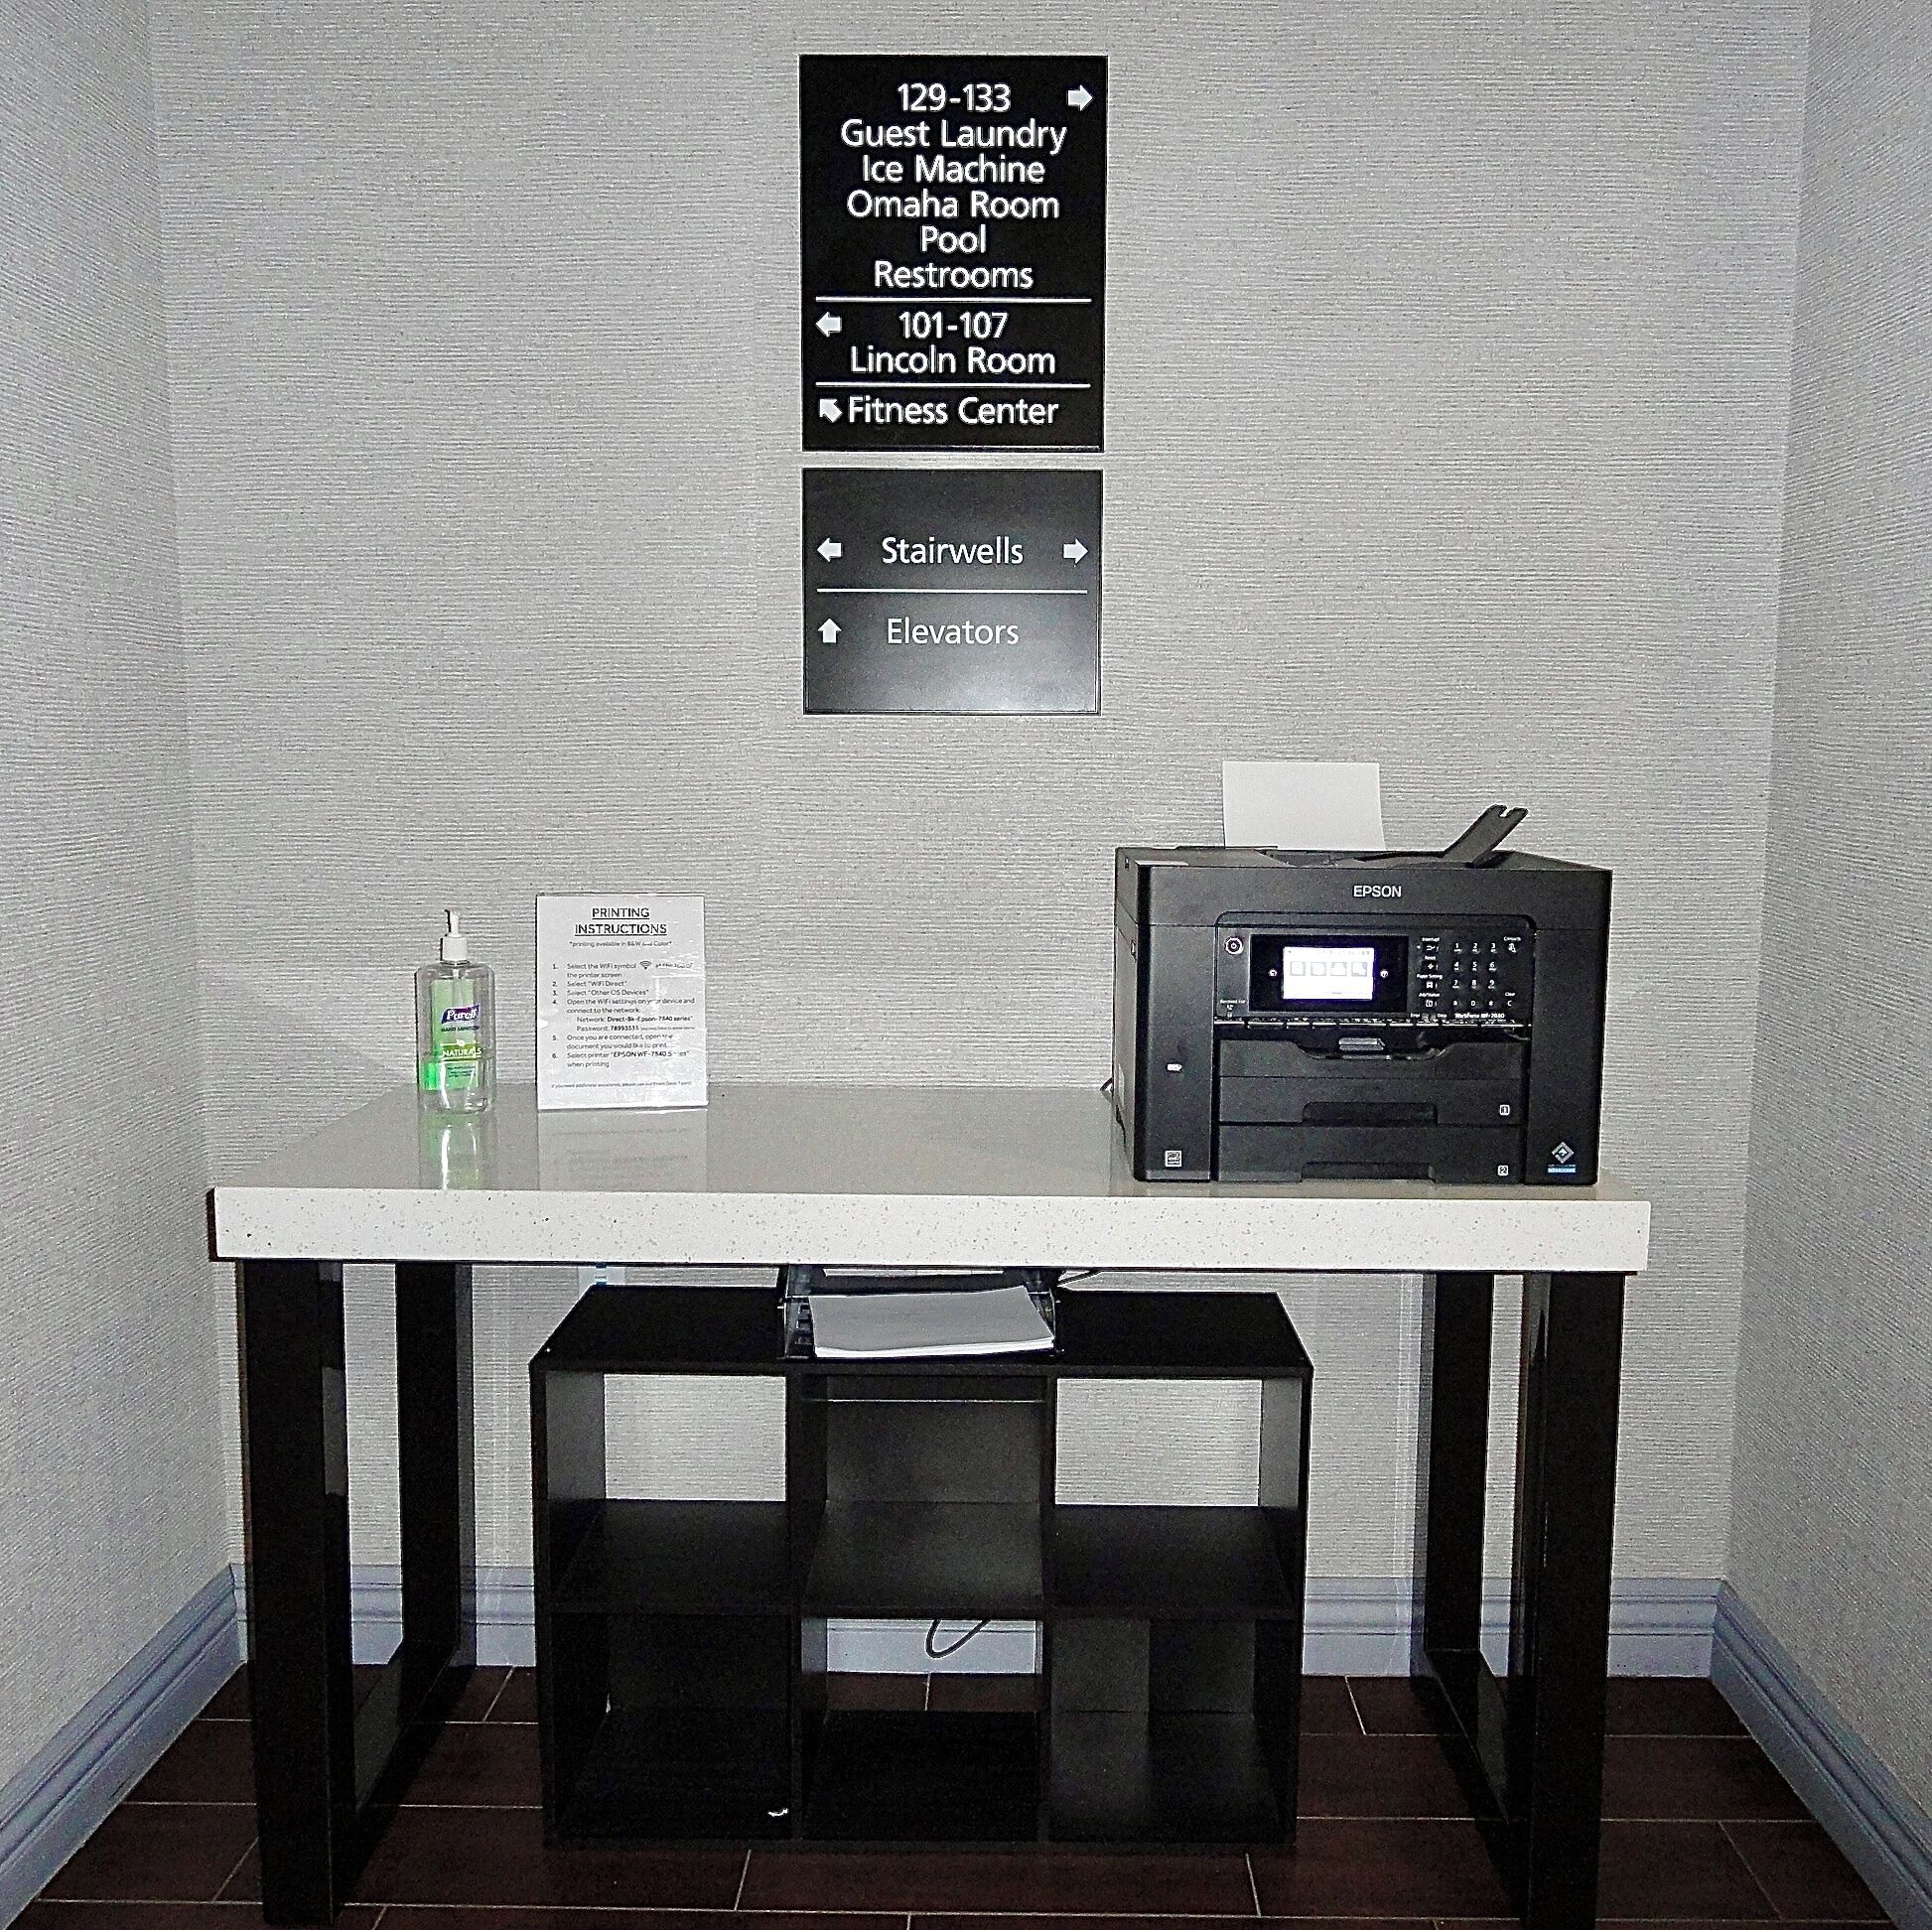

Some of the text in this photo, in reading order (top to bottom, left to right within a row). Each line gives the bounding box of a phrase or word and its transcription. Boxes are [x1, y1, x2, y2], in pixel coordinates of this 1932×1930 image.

[897, 83, 1011, 111] 129-133
[841, 118, 1067, 155] Guest Laundry
[863, 154, 1045, 183] Ice Machine
[847, 189, 1060, 218] Omaha Room
[921, 224, 987, 253] Pool
[875, 260, 1034, 289] Restrooms
[898, 311, 1009, 339] 101-107
[851, 345, 1055, 373] Lincoln Room
[849, 395, 1059, 424] Fitness Center
[882, 536, 1024, 564] Stairwells
[887, 617, 1020, 645] Elevators
[1353, 885, 1402, 897] EPSON
[592, 907, 650, 919] PRINTING
[575, 923, 667, 936] INSTRUCTIONS
[442, 1047, 482, 1056] NATURALS
